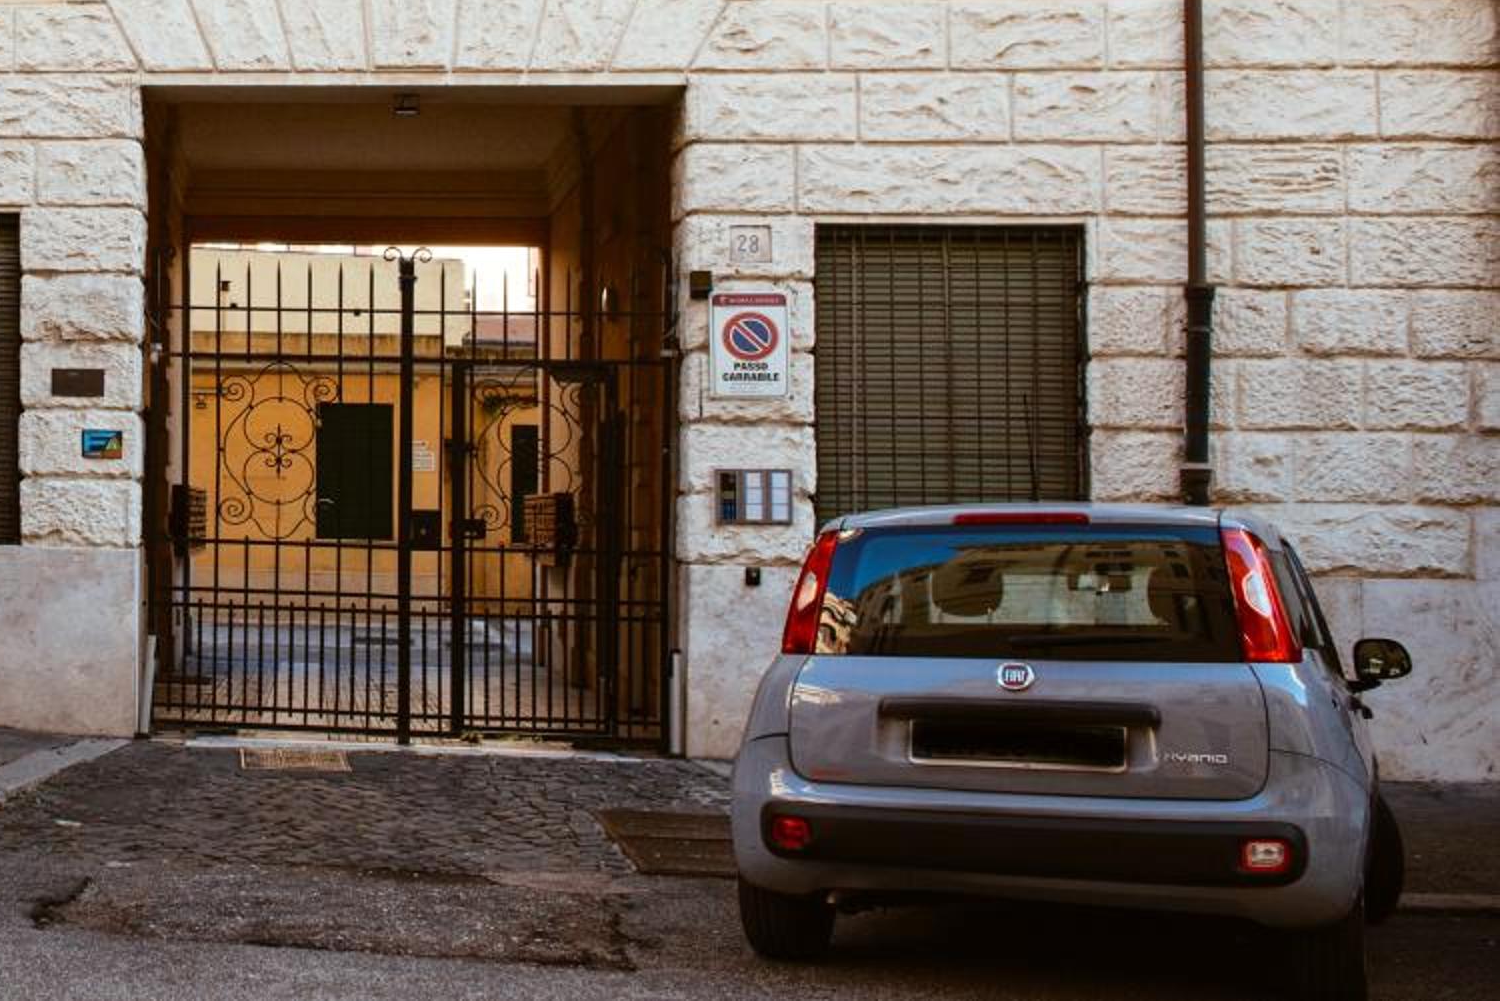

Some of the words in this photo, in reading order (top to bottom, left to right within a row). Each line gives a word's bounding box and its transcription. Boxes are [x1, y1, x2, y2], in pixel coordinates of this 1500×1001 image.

[737, 234, 759, 254] 28
[733, 362, 769, 371] PASSO
[722, 372, 780, 381] CARRABILE
[1005, 669, 1026, 683] FIAT
